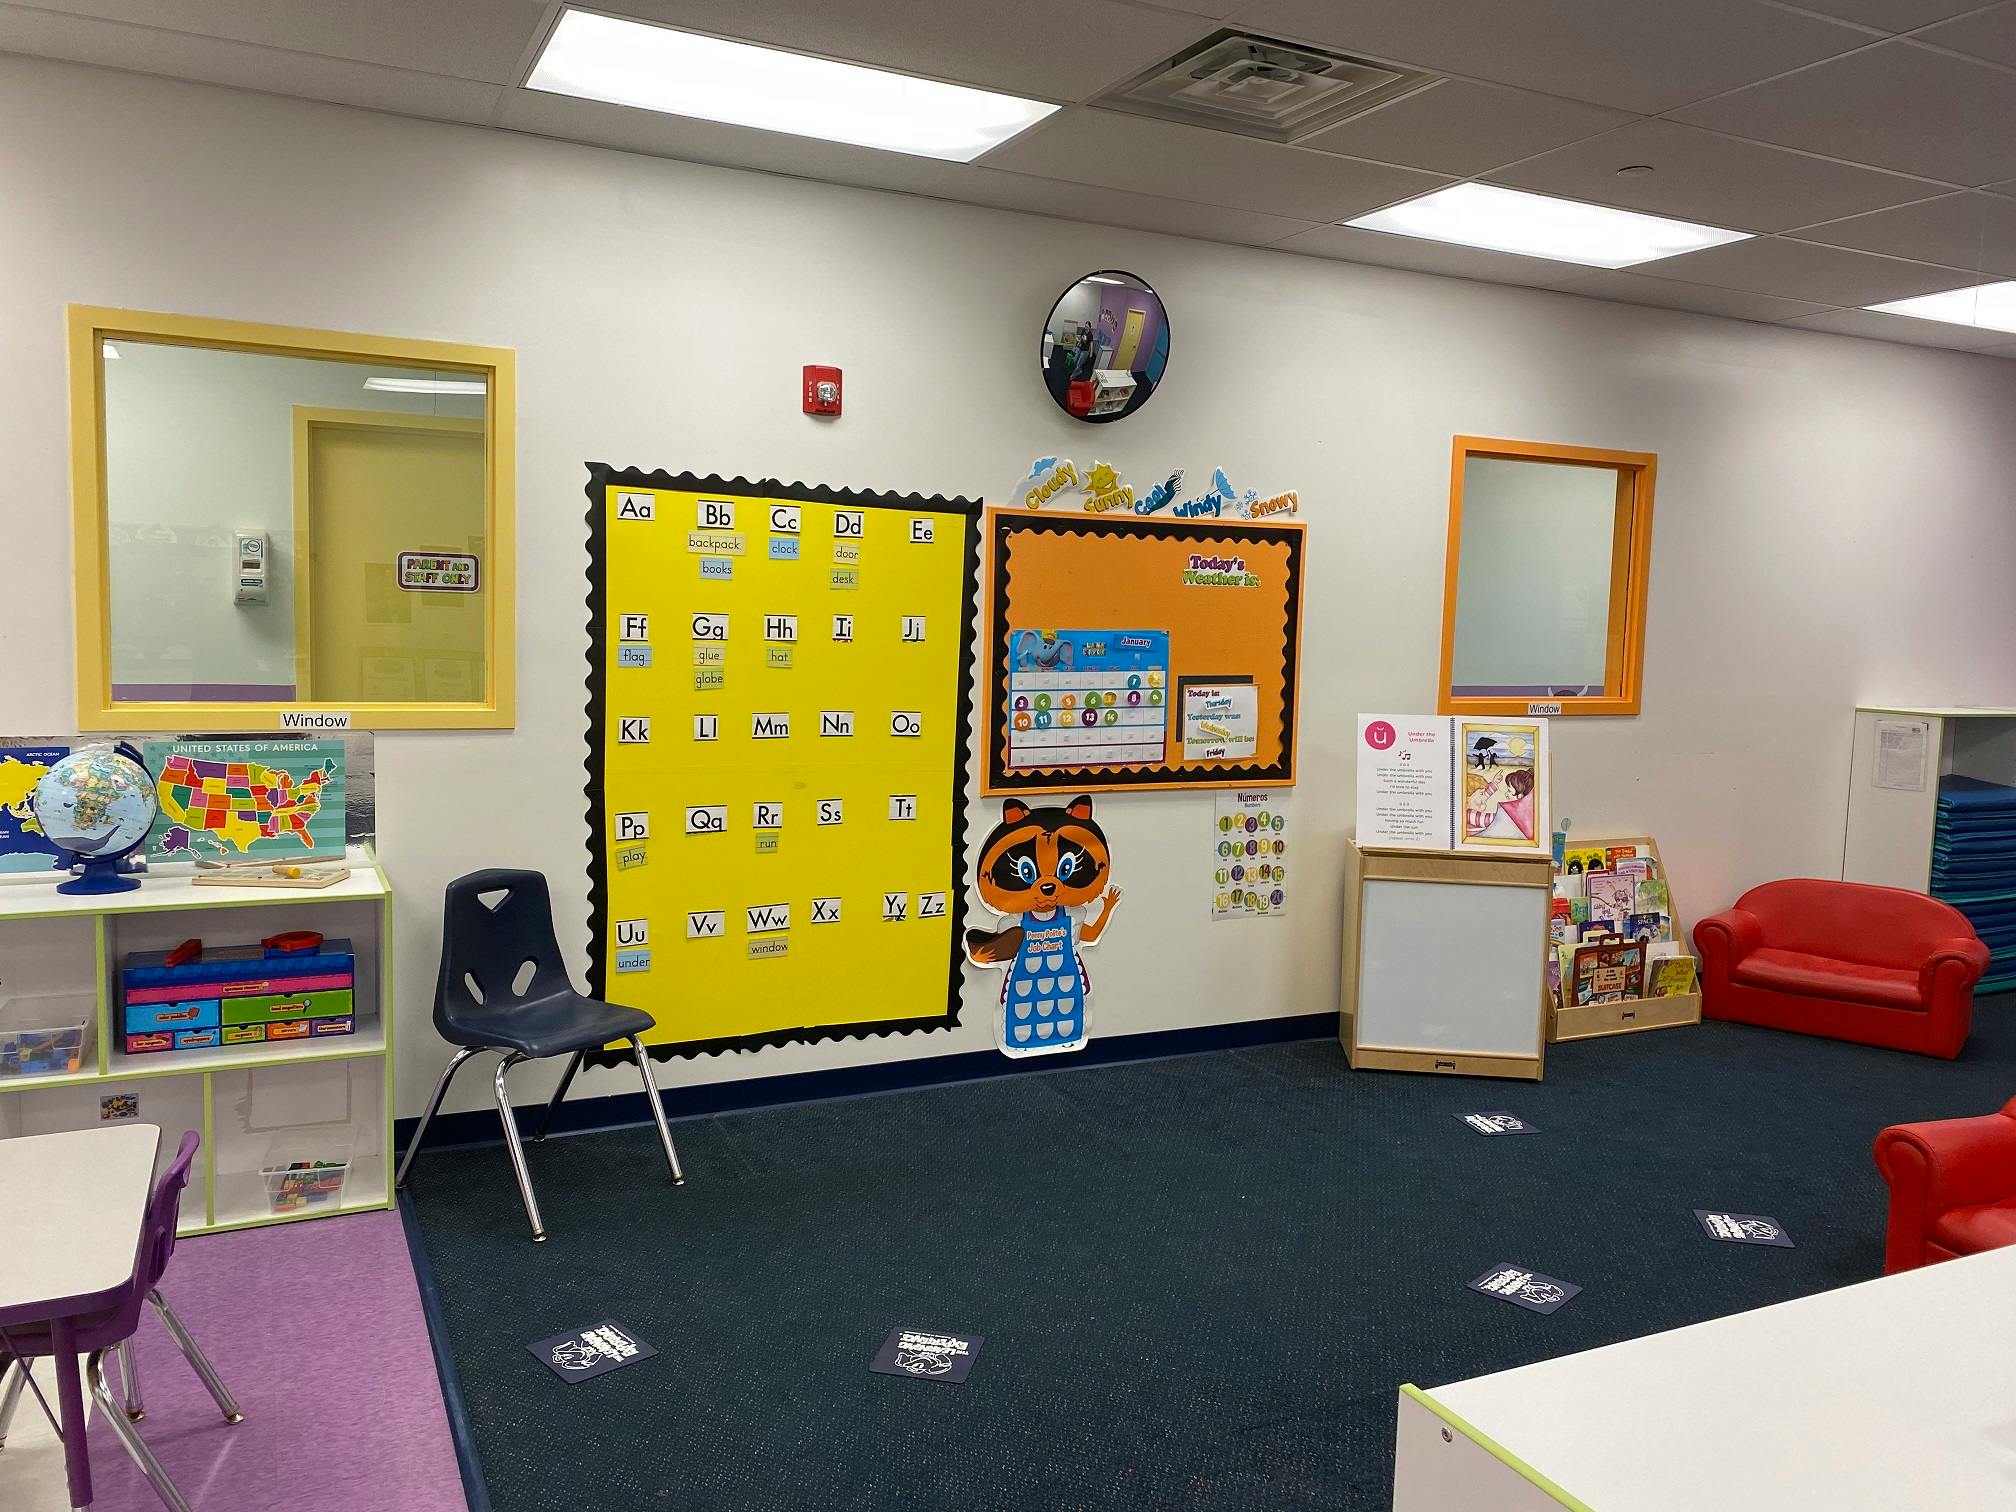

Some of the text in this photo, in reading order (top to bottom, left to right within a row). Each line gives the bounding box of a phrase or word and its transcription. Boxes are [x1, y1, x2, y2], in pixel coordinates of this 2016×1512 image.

[1025, 463, 1077, 510] Cloudy
[1084, 486, 1133, 513] Sunny
[1134, 484, 1168, 516] Cool
[1173, 494, 1222, 518] Windy
[1250, 491, 1298, 518] Snowy
[619, 496, 651, 519] Aa
[706, 503, 731, 526] Bb
[771, 508, 797, 531] Cc
[835, 514, 862, 536] Dd
[912, 520, 934, 541] Ee
[688, 534, 741, 552] backpack
[771, 542, 798, 555] clock
[835, 547, 859, 560] door
[407, 559, 470, 572] PARENT AND
[702, 561, 733, 576] books
[1189, 555, 1245, 573] Today's
[405, 571, 472, 584] STAFF ONLY
[832, 571, 855, 585] desk
[1183, 570, 1243, 585] Weather
[626, 616, 648, 638] Ff
[692, 615, 724, 640] Gg
[766, 617, 793, 639] Hh
[835, 617, 852, 638] Ii
[903, 617, 921, 641] Jj
[1121, 635, 1152, 647] January
[623, 648, 646, 666] flag
[698, 648, 720, 663] glue
[770, 649, 789, 662] hat
[695, 672, 724, 688] globe
[1187, 689, 1210, 698] Today
[1205, 697, 1232, 708] Thursday
[1529, 704, 1561, 714] Window
[283, 713, 348, 728] Window
[892, 713, 920, 734] Oo
[1018, 718, 1029, 728] 10
[1038, 714, 1048, 724] 11
[1062, 713, 1072, 722] 12
[1085, 711, 1095, 722] 13
[1187, 713, 1223, 721] Yesterday
[621, 719, 649, 741] Kk
[753, 716, 789, 737] Mm
[822, 715, 850, 735] Nn
[172, 744, 211, 753] UNITED
[215, 744, 251, 752] STATES
[272, 743, 319, 752] AMERICA
[1206, 748, 1226, 758] Friday
[1237, 792, 1269, 803] Números
[757, 804, 778, 825] Rr
[820, 802, 842, 823] Ss
[895, 798, 913, 819] Tt
[690, 809, 723, 832] Qq
[1223, 815, 1229, 830] 1
[1237, 814, 1244, 827] 2
[1248, 818, 1255, 832] 3
[1260, 812, 1267, 826] 4
[1274, 818, 1281, 831] 5
[621, 815, 646, 839] Pp
[759, 838, 777, 848] run
[1221, 843, 1228, 857] 6
[1235, 842, 1242, 855] 7
[1249, 841, 1256, 855] 8
[1261, 840, 1268, 853] 9
[1273, 841, 1283, 853] 10
[622, 848, 646, 865] play
[1218, 869, 1228, 882] 11
[1233, 866, 1243, 880] 12
[1246, 868, 1257, 882] 13
[1260, 865, 1271, 878] 14
[1273, 867, 1283, 880] 15
[1219, 893, 1229, 907] 16
[1232, 890, 1242, 903] 17
[1246, 893, 1256, 907] 18
[1259, 894, 1269, 908] 19
[1271, 891, 1283, 903] 20
[811, 900, 839, 922] Xx
[885, 894, 907, 918] Yy
[921, 895, 945, 916] Zz
[691, 915, 717, 935] Vv
[747, 908, 788, 929] Ww
[617, 923, 645, 944] Uu
[1027, 931, 1045, 941] Penny
[751, 940, 788, 954] window
[1028, 940, 1063, 953] Job Chart
[618, 956, 650, 969] under
